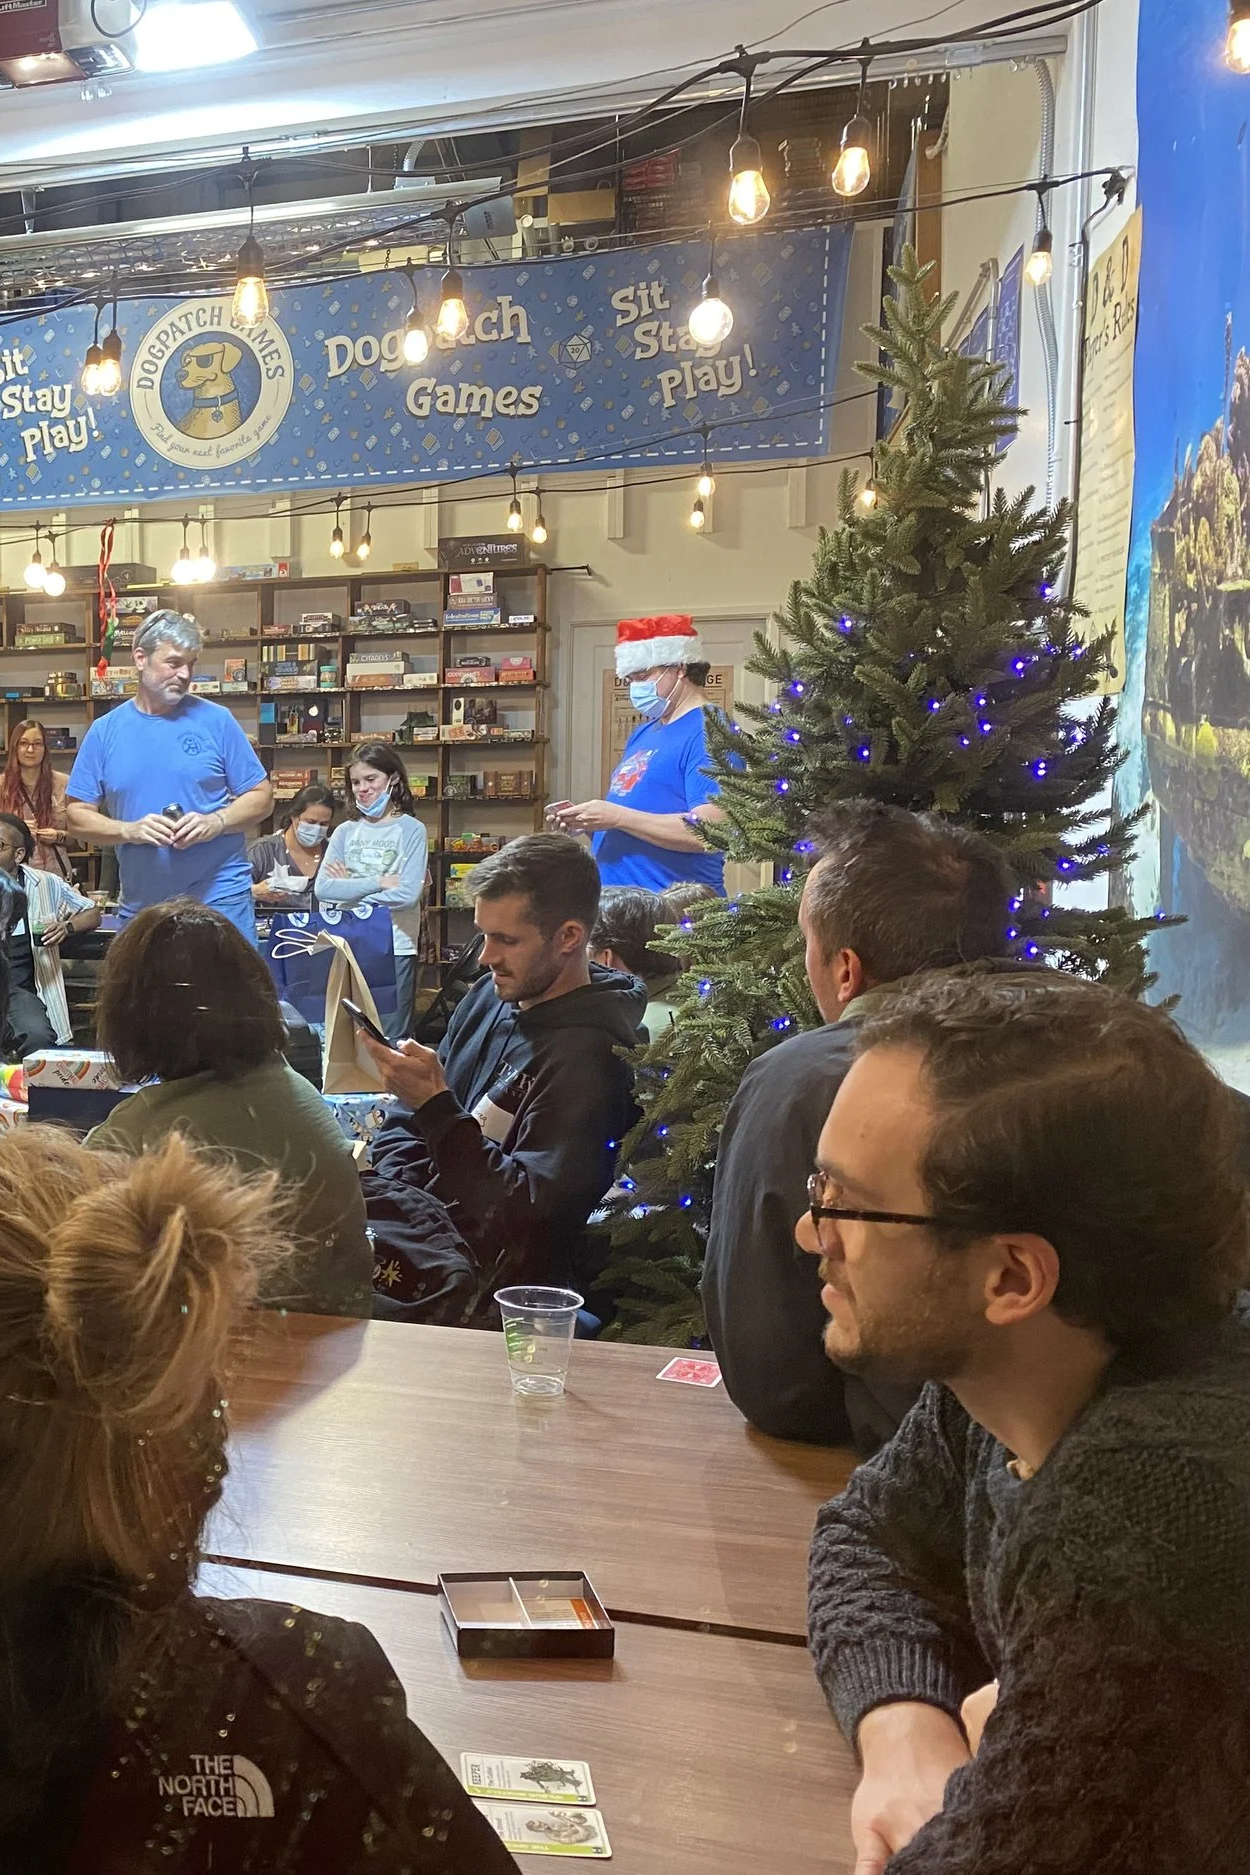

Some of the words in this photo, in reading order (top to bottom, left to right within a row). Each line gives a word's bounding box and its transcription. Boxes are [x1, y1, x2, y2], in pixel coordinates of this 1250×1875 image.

[611, 280, 671, 328] Sit
[136, 305, 223, 391] DOGPATCH
[657, 343, 758, 409] Play!
[2, 383, 73, 421] Stay
[406, 377, 543, 418] Games
[20, 406, 100, 464] Play!
[150, 422, 174, 445] Find
[166, 433, 191, 453] your
[192, 447, 214, 458] next
[215, 433, 253, 459] favorite
[253, 414, 273, 441] game
[360, 654, 389, 662] CITADELS
[189, 1754, 233, 1774] THE
[158, 1775, 235, 1797] NORTH
[182, 1797, 237, 1818] FACE
